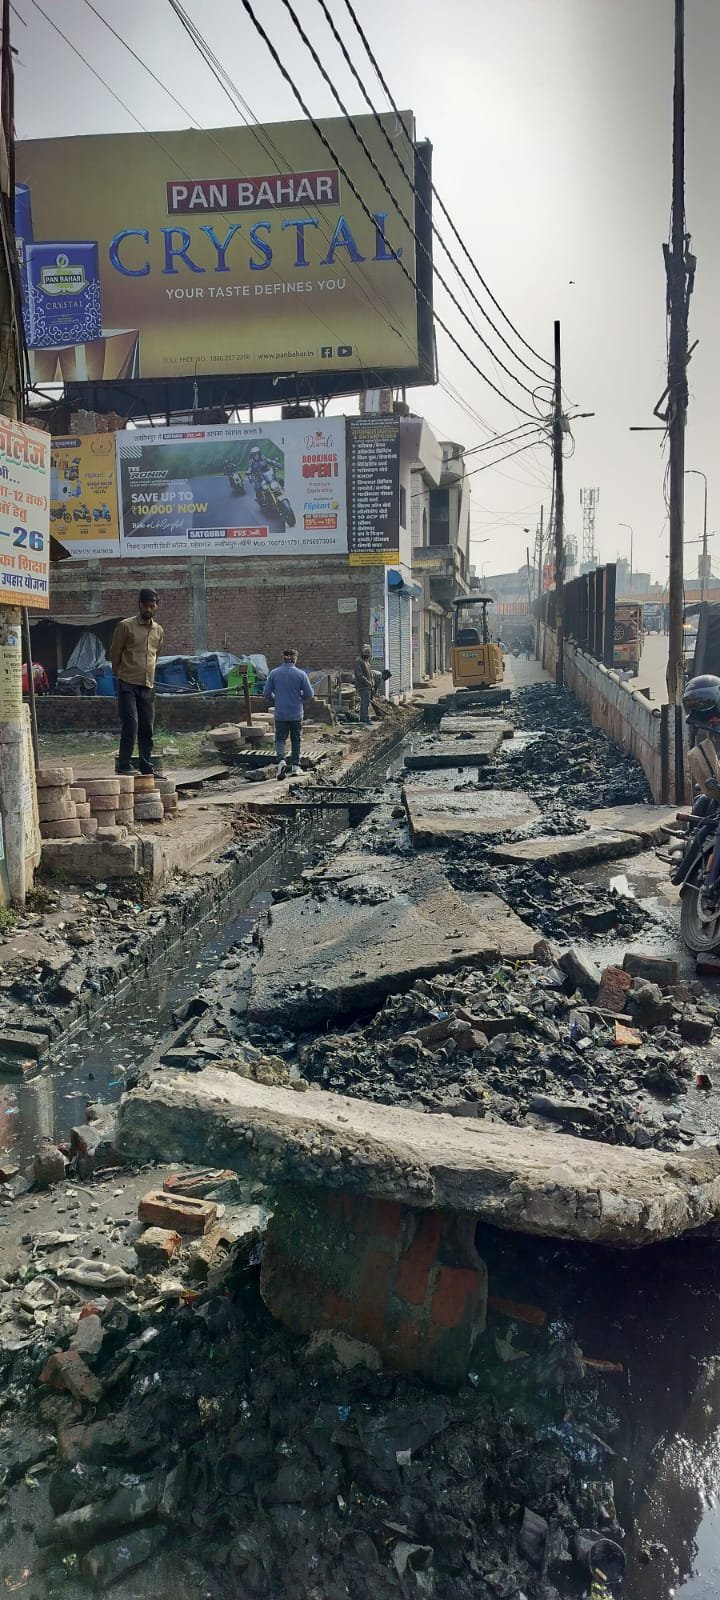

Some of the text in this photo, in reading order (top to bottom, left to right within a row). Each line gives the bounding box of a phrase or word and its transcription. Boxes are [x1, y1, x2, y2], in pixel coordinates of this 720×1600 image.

[172, 176, 333, 209] PAN BAHAR
[109, 212, 404, 277] CRYSTAL
[45, 275, 81, 284] PAN BAHAR
[166, 279, 346, 300] YOUR TASTE DEFINES YOU
[45, 301, 83, 310] CRYSTAL
[257, 350, 314, 361] www.panbahar.in
[302, 454, 337, 463] BOOKINGS
[128, 470, 169, 480] RONIN
[302, 463, 332, 478] OPEN
[131, 491, 194, 503] SAVE UP TO
[177, 502, 208, 514] NOW
[303, 502, 331, 511] Flipkart
[189, 528, 247, 539] SATGURU TVS
[18, 554, 47, 575] शिक्षा
[1, 572, 47, 592] उपहार योजना
